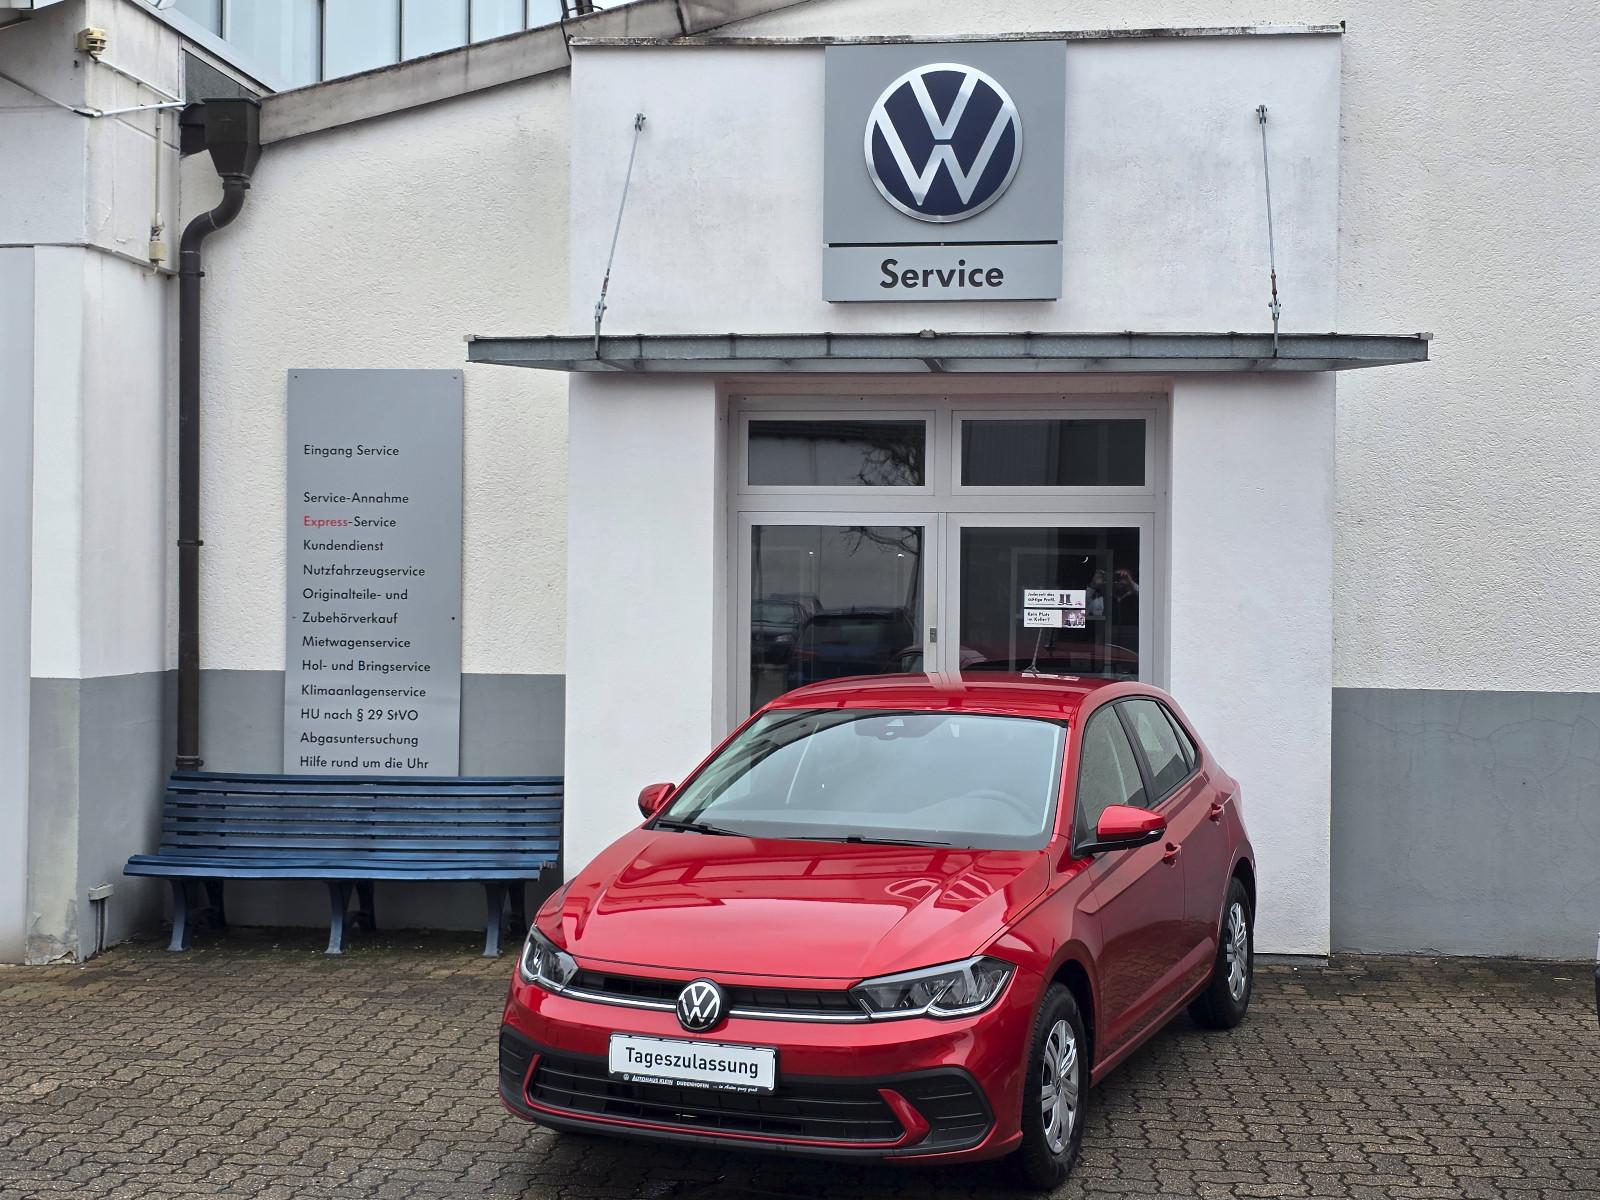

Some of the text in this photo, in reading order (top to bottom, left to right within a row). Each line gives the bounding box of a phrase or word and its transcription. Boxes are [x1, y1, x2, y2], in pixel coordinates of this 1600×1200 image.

[879, 258, 1005, 289] Service
[303, 444, 400, 458] Eingang Service
[303, 491, 409, 504] Service-Annahme
[303, 515, 397, 529] Express-Service
[303, 538, 384, 551] Kundendienst
[303, 563, 426, 579] Nutzfahrzeugservice
[302, 587, 408, 602] Originalteile- und
[302, 611, 399, 624] Zubehörverkauf
[302, 636, 411, 650] Mietwagenservice
[302, 659, 431, 675] Hol- und Bringservice
[301, 684, 426, 699] Klimaanlagenservice
[300, 708, 419, 722] HU nach § 29 StVO
[300, 731, 419, 748] Abgasuntersuchung
[299, 755, 429, 769] Hilfe rund um die Uhr
[625, 1047, 759, 1079] Tageszulassung
